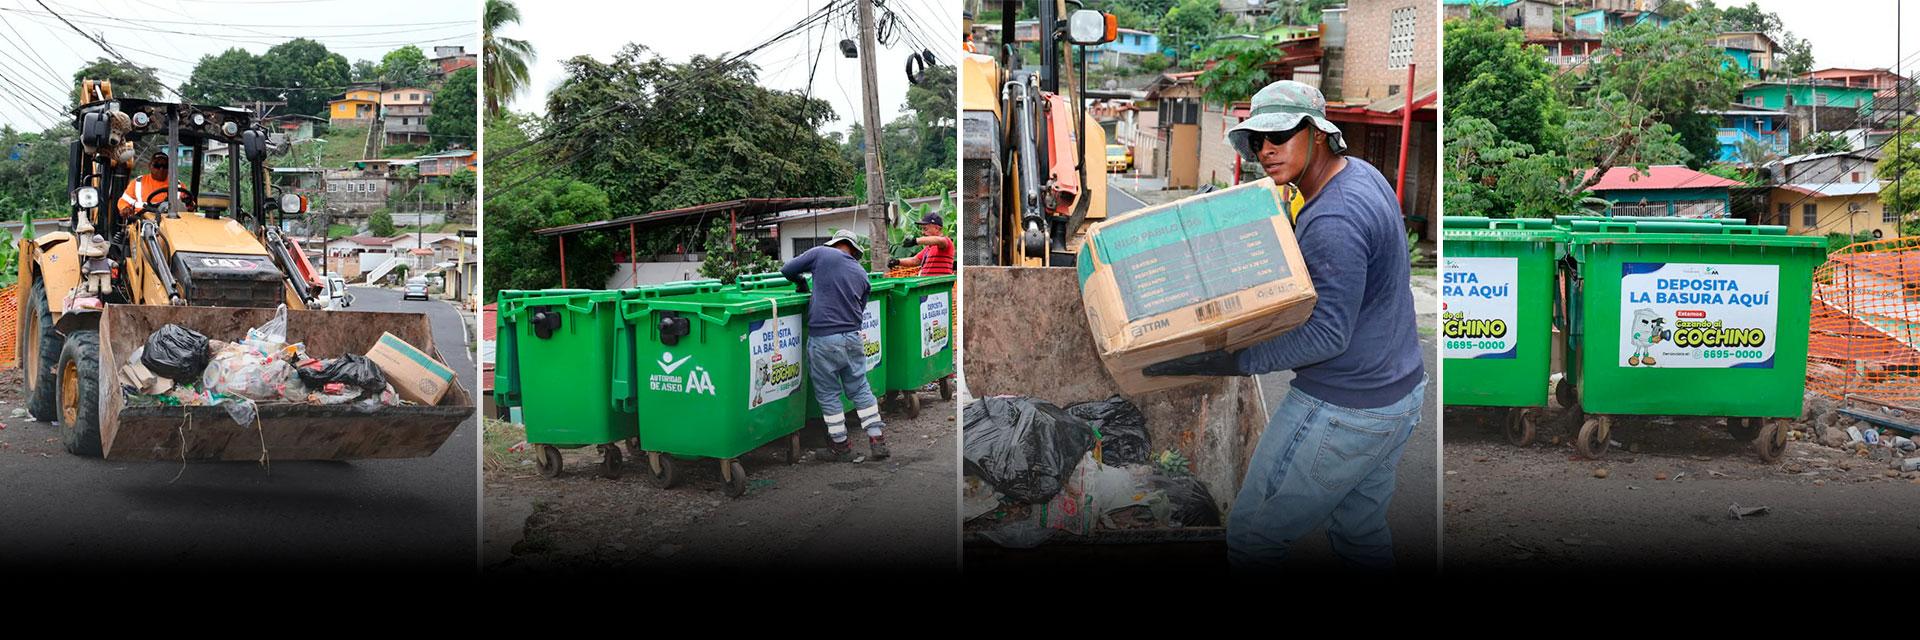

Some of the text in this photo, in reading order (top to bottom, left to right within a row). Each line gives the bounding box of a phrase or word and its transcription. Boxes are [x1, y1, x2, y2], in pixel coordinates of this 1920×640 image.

[201, 258, 240, 268] CAT
[1657, 279, 1739, 291] DEPOSITA
[1468, 283, 1509, 299] AQUÍ
[1630, 291, 1770, 308] LA BASURA AQUÍ
[1455, 311, 1464, 319] al
[1675, 320, 1722, 329] Cazando al
[1673, 328, 1766, 348] COCHINO
[753, 345, 762, 355] LA
[1447, 341, 1505, 349] 6695-0000
[1703, 350, 1763, 359] 6695-0000
[650, 374, 682, 384] AUTORIDAD
[650, 381, 683, 392] DE ASEO
